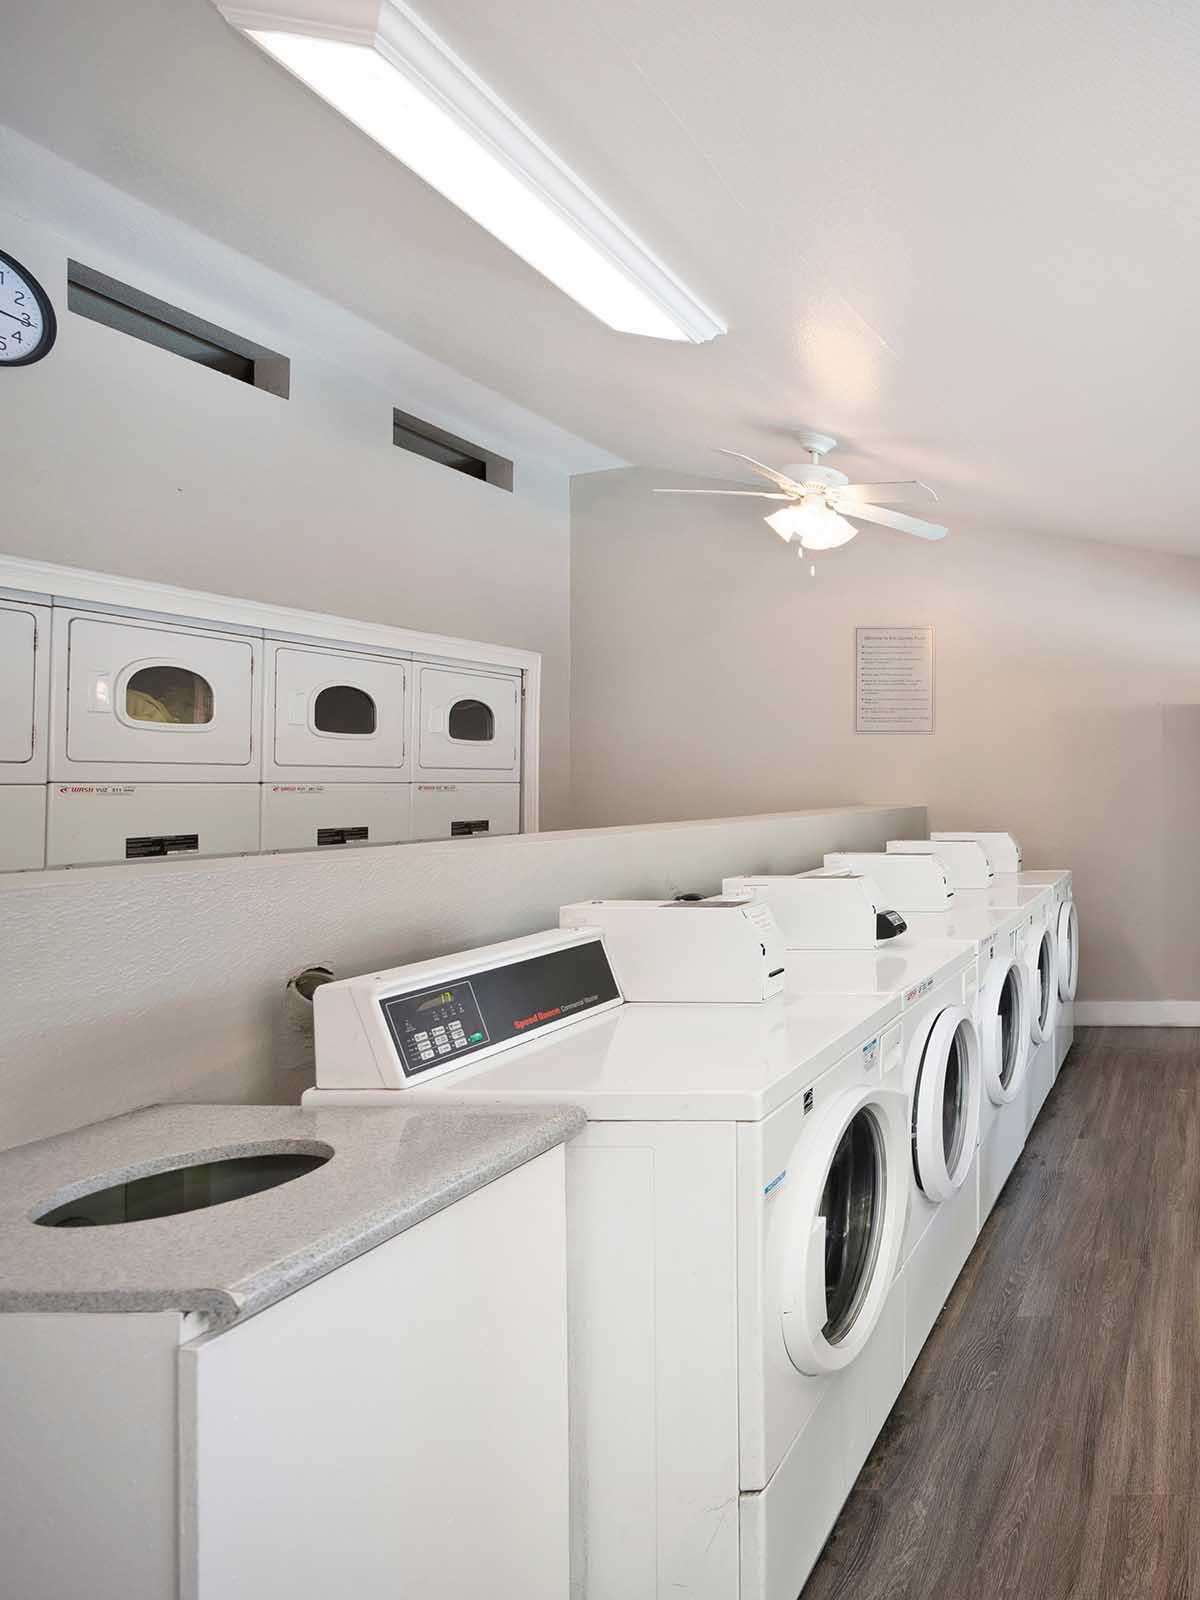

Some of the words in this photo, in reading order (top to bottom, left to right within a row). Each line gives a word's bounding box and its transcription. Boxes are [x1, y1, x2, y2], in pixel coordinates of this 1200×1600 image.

[14, 290, 24, 307] 2
[21, 313, 31, 327] 3
[11, 331, 23, 344] 4
